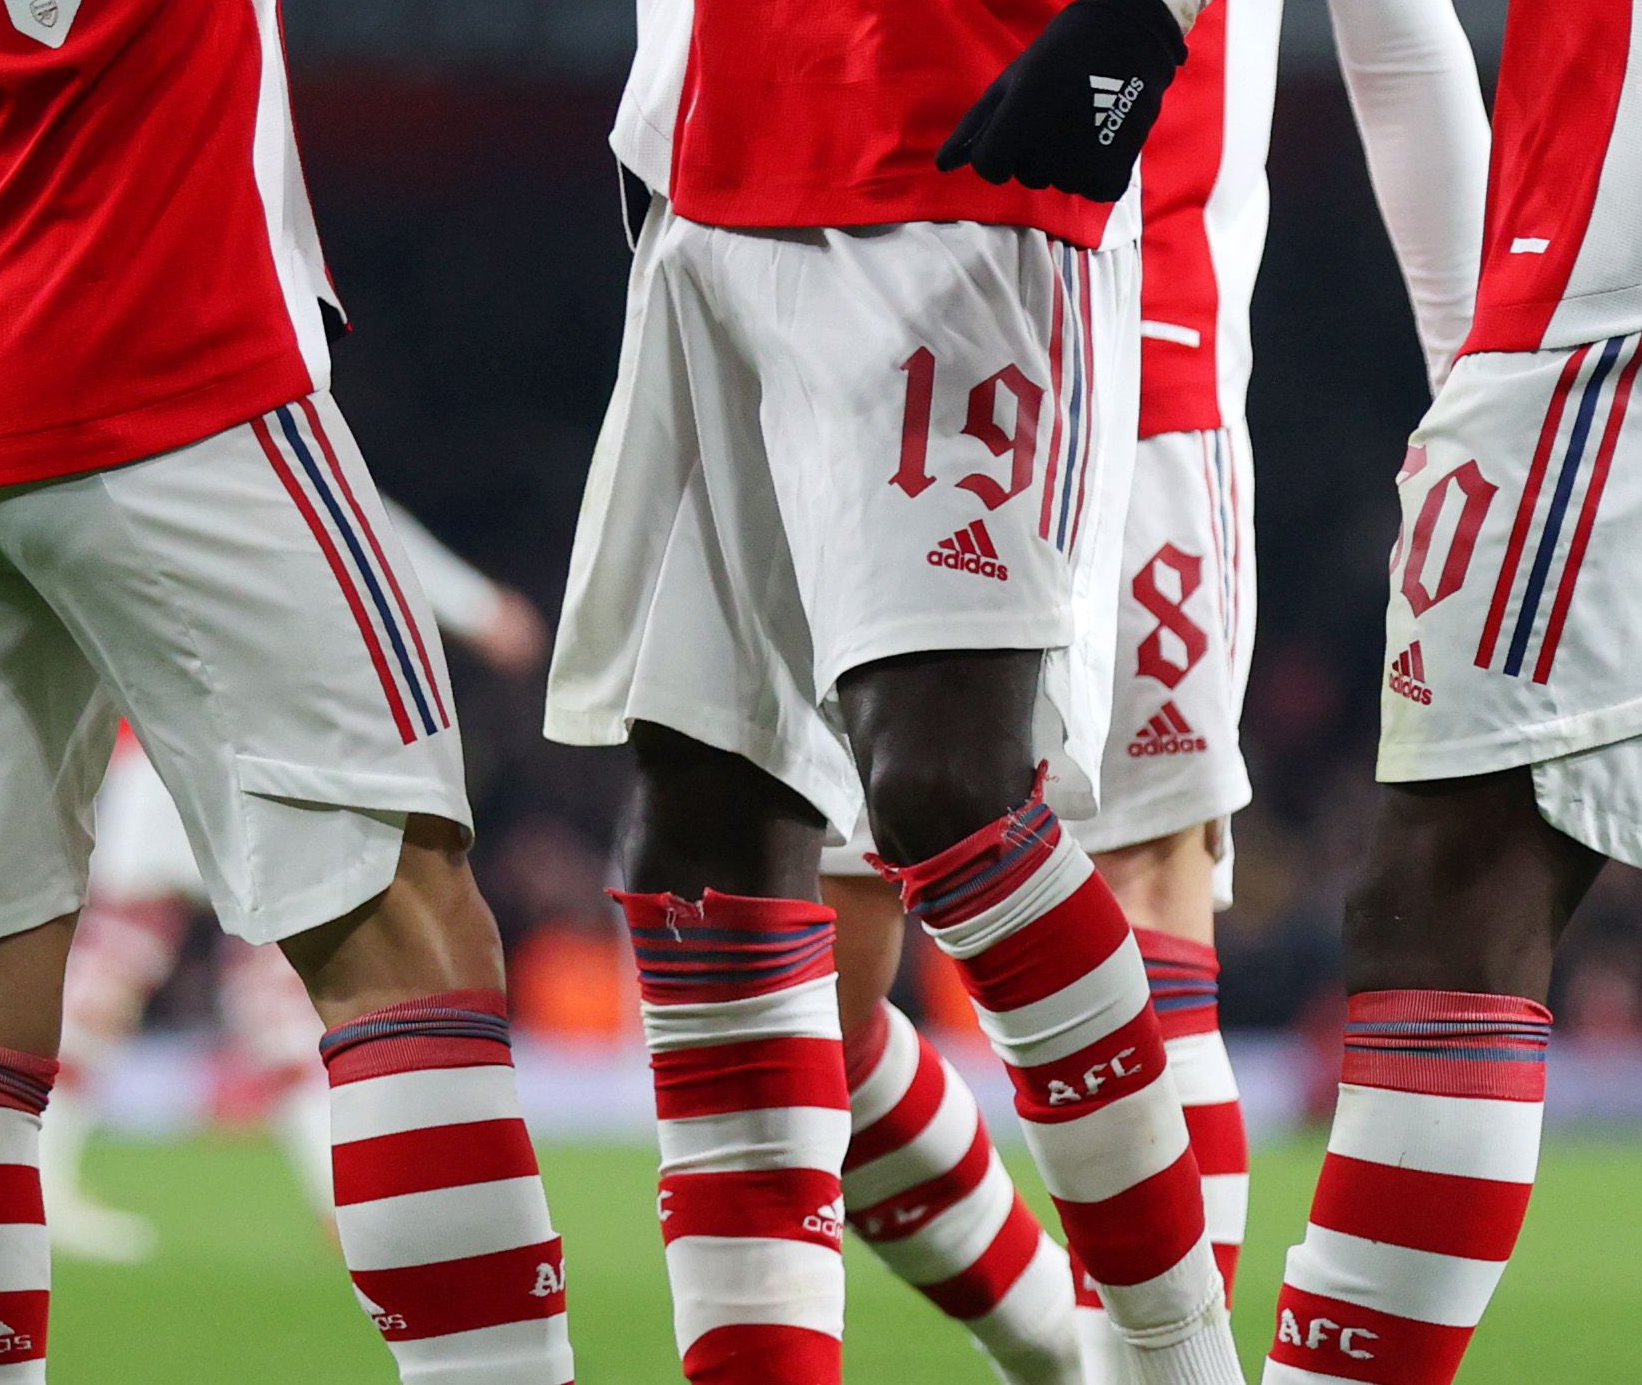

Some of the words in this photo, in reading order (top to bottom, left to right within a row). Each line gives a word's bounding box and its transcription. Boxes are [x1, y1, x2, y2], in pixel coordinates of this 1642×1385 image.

[1098, 76, 1145, 146] adidas
[887, 345, 1048, 512] 19
[926, 547, 1009, 582] adidas
[1132, 542, 1208, 690] 8
[1127, 734, 1207, 758] adidas
[1047, 1046, 1144, 1107] AFC
[1278, 1307, 1380, 1360] AFC
